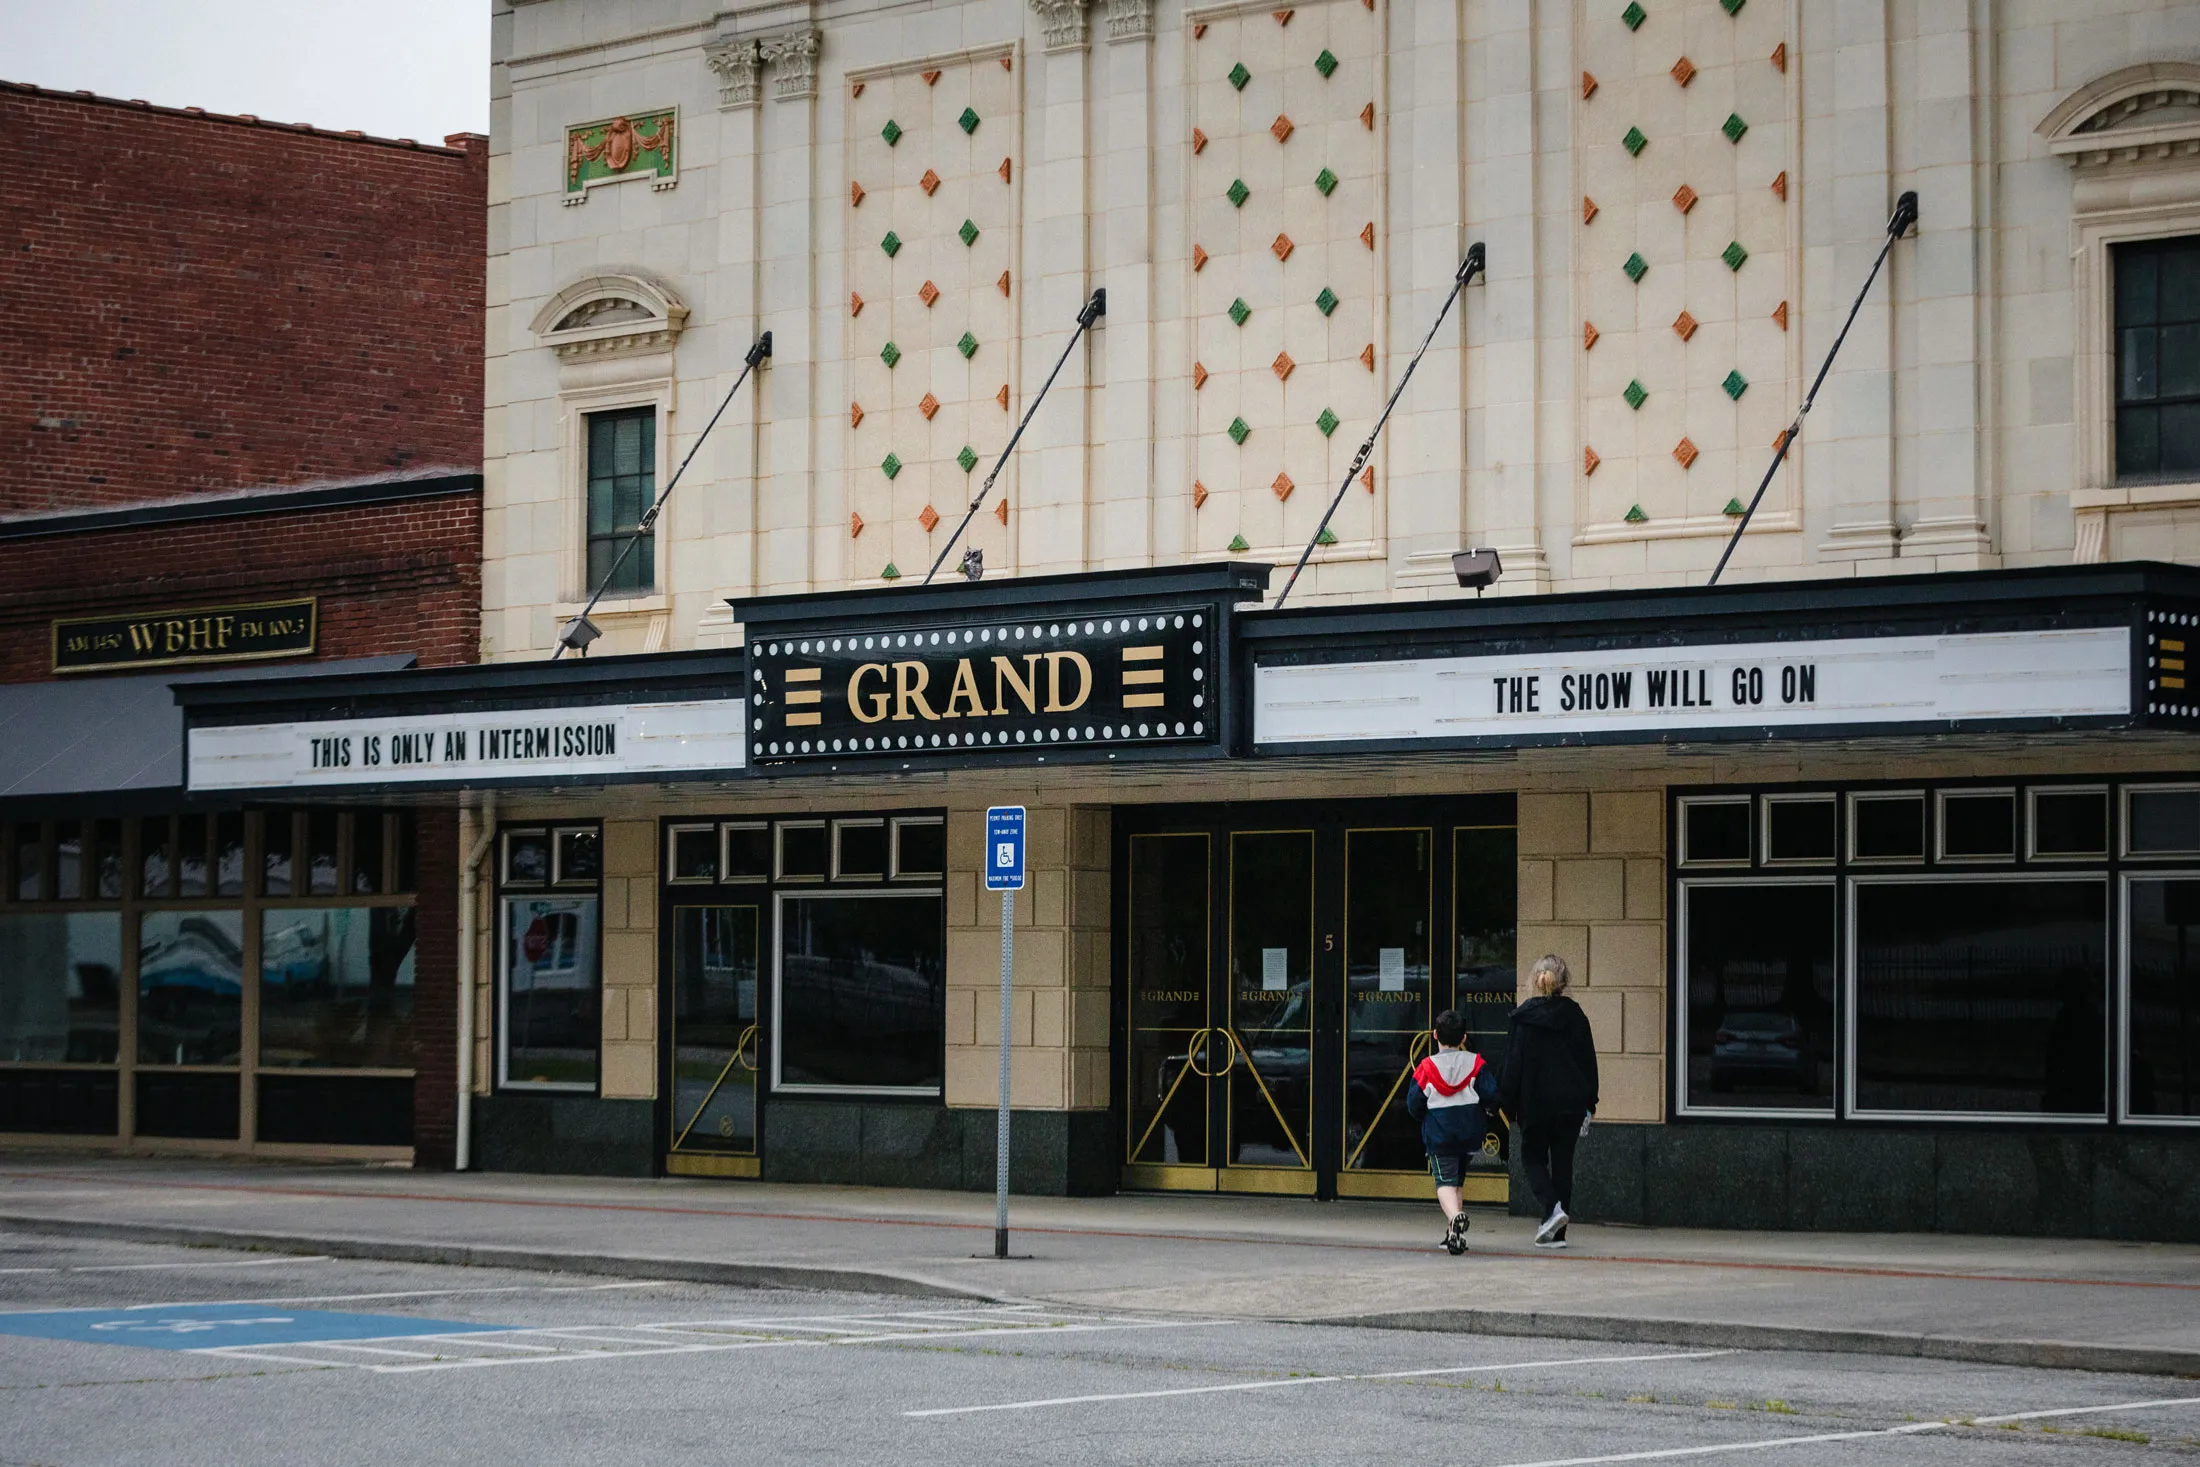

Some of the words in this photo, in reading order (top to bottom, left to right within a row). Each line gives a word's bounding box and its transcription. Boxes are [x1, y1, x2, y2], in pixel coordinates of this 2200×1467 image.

[66, 637, 89, 652] AM
[128, 616, 235, 653] WBHF
[240, 622, 264, 638] FM
[847, 650, 1093, 724] GRAND
[1493, 676, 1539, 714] THE
[1560, 671, 1632, 712] SHOW
[1647, 669, 1711, 708] WILL
[1732, 667, 1763, 706] GO
[1782, 665, 1815, 704] ON
[311, 737, 351, 767] THIS
[364, 736, 380, 765] IS
[392, 733, 435, 765] ONLY
[444, 731, 466, 761] AN
[479, 723, 616, 760] INTERMISSION
[1324, 934, 1333, 952] 5
[1148, 991, 1192, 1002] GRAND
[1248, 991, 1294, 1002] GRAND
[1366, 991, 1413, 1003] GRAND
[1474, 992, 1517, 1004] GRAN
